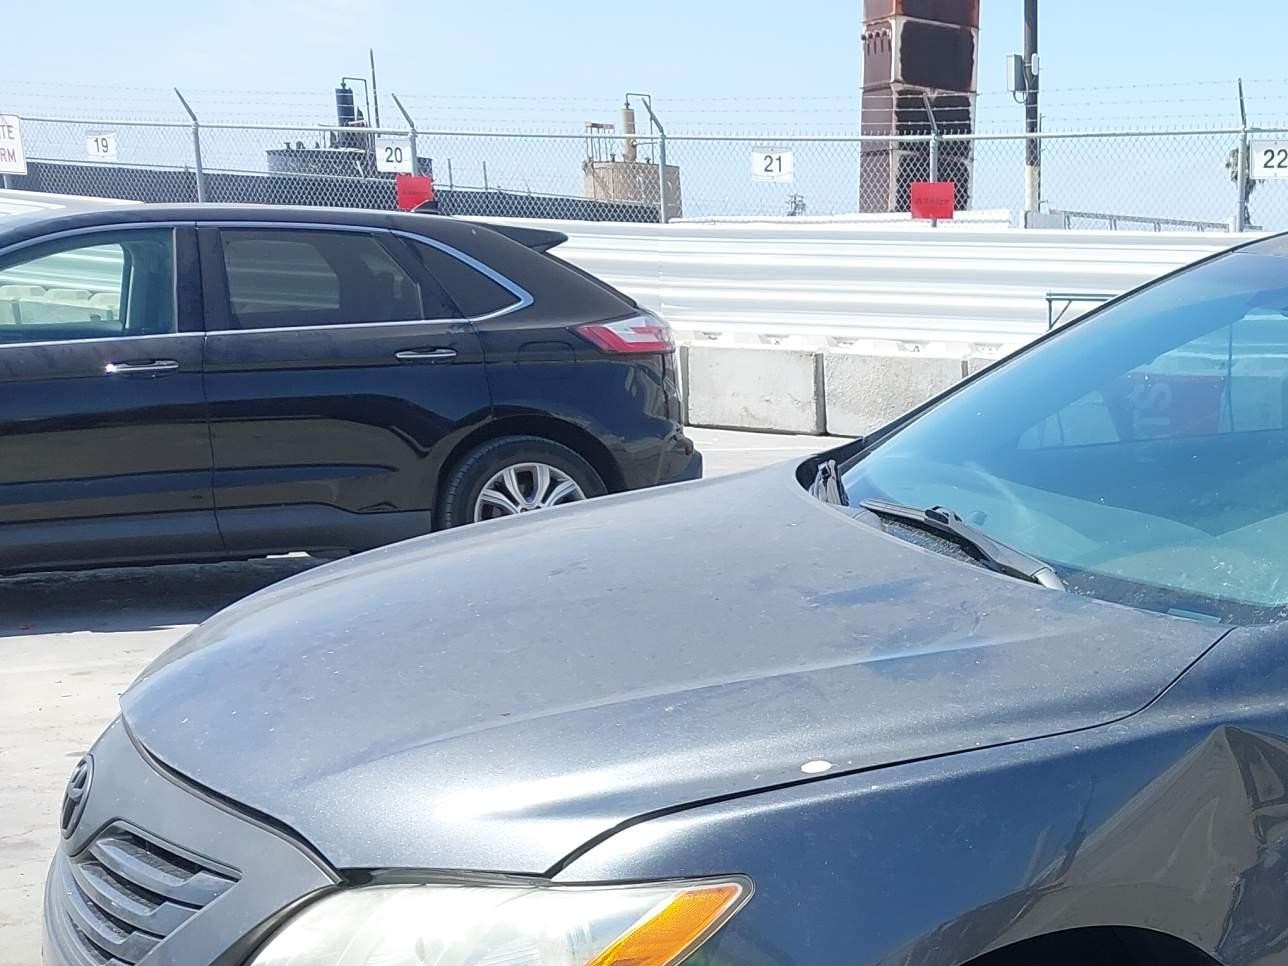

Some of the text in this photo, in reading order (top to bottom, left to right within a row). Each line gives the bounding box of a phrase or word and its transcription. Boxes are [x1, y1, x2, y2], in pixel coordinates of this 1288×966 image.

[94, 137, 109, 153] 19
[385, 147, 403, 163] 20
[763, 154, 783, 172] 21
[1263, 149, 1288, 168] 22
